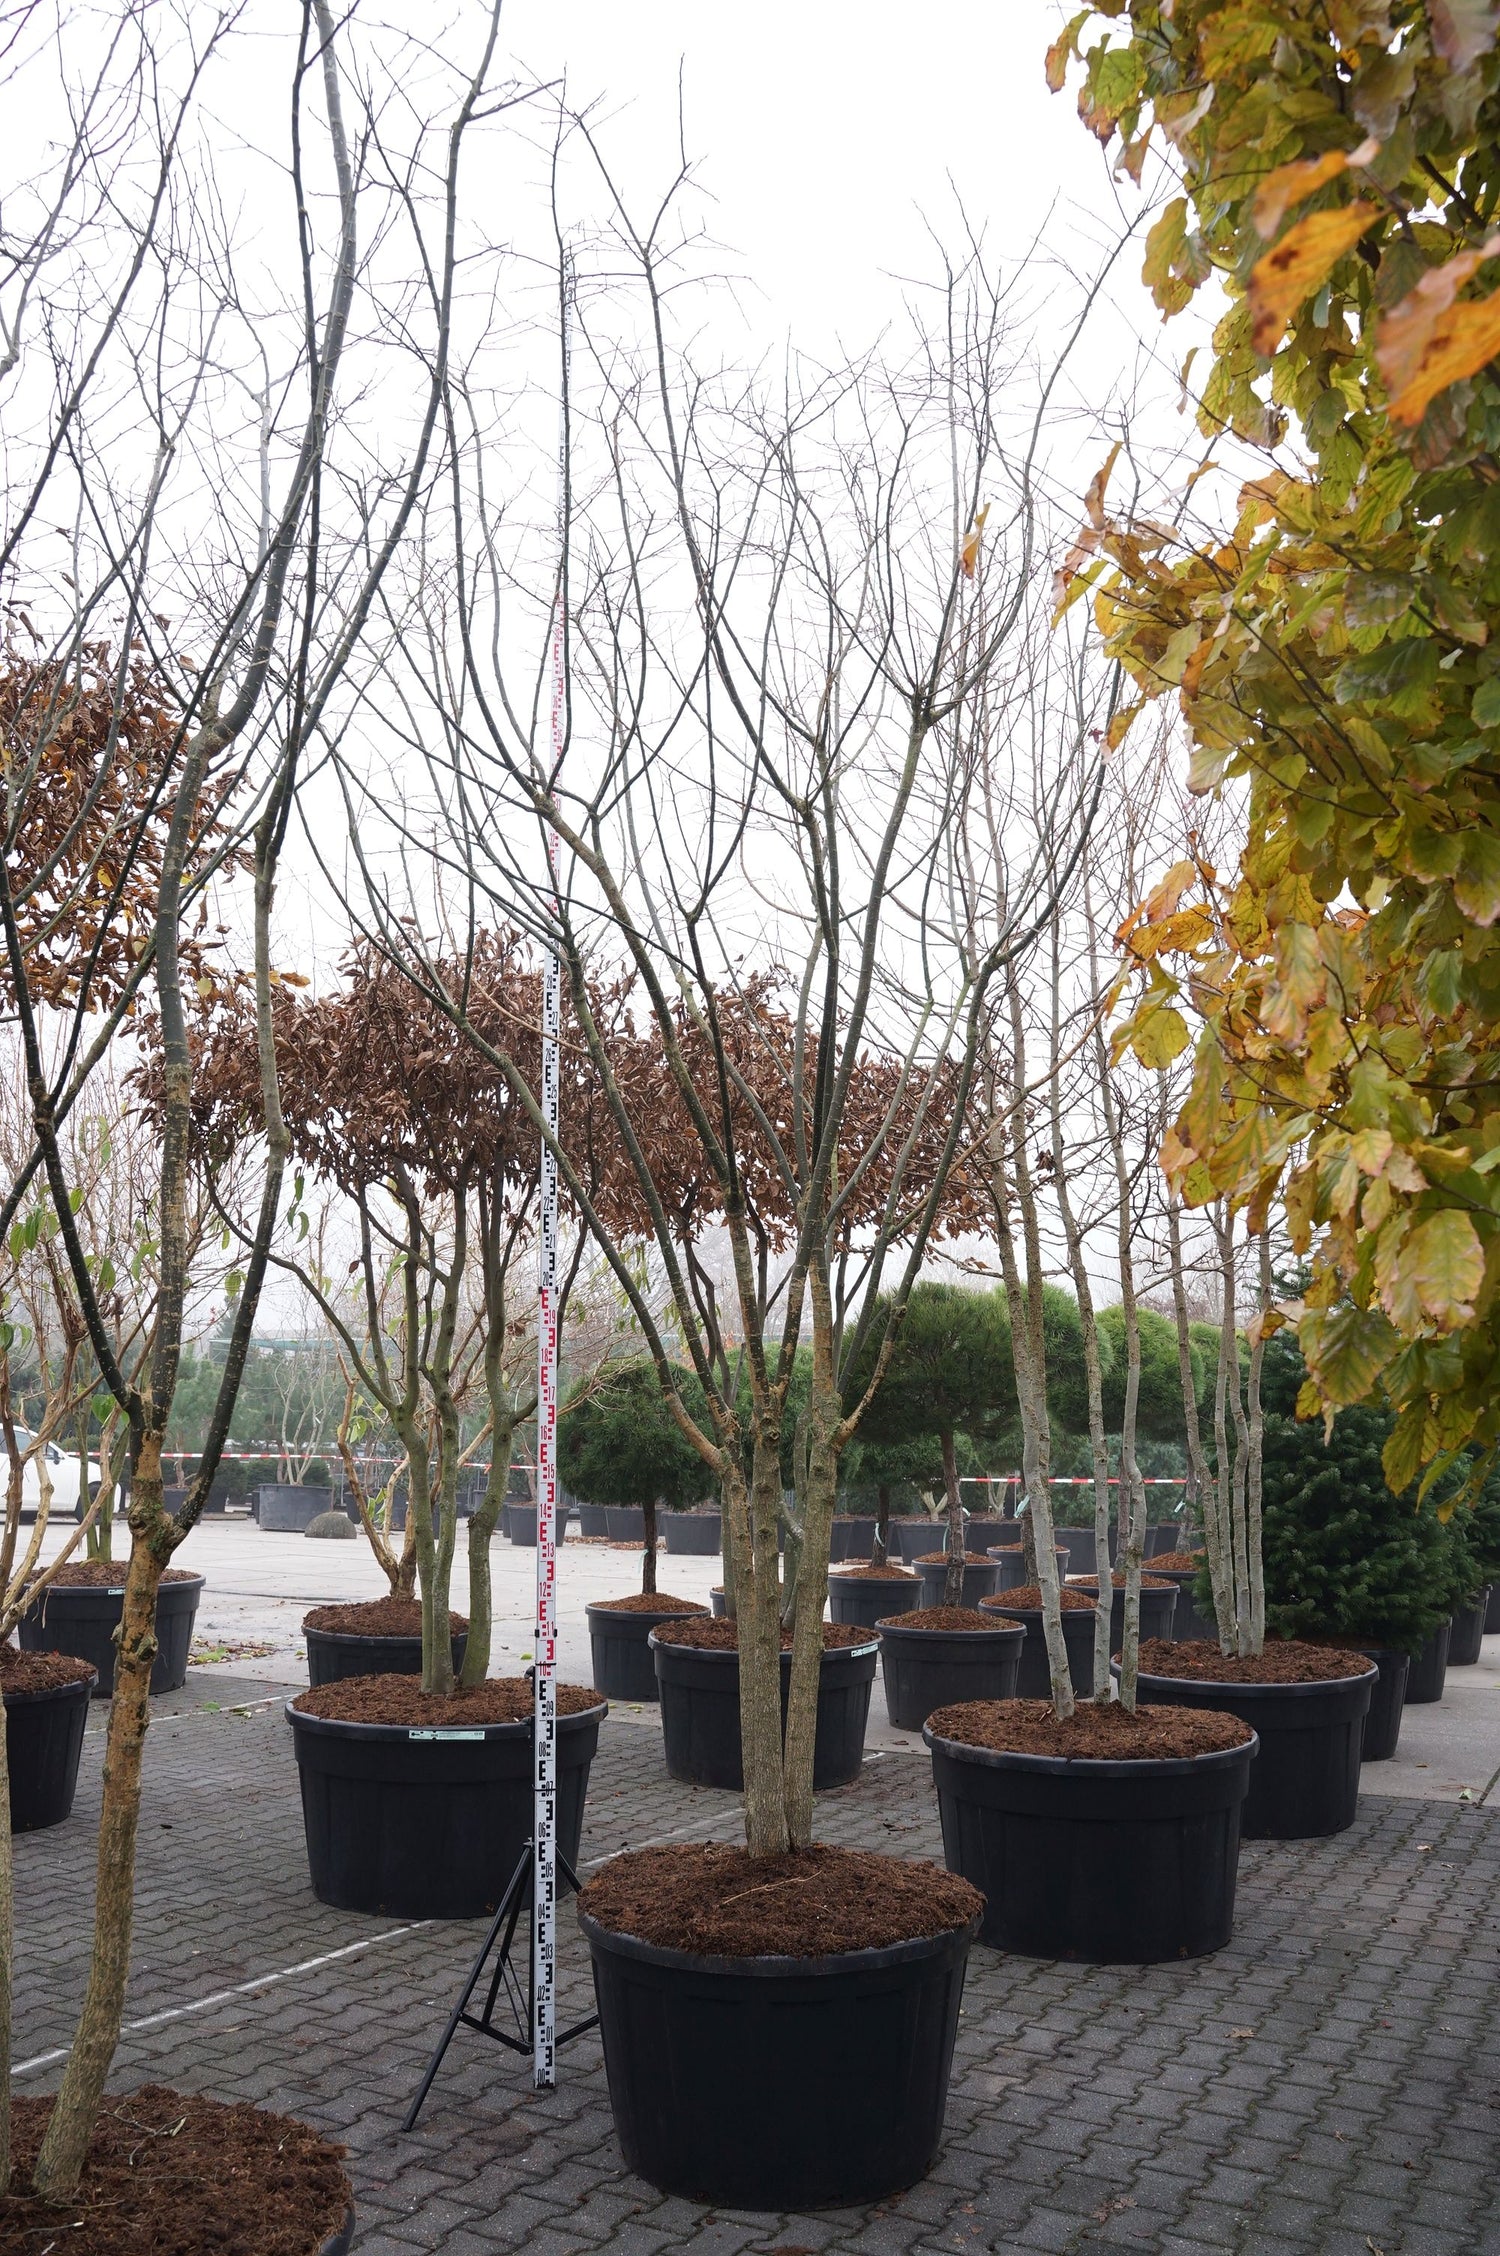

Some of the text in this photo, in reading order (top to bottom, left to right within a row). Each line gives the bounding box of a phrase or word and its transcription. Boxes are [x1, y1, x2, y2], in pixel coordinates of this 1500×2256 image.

[552, 1011, 558, 1025] 27
[550, 1085, 557, 1098] 25
[550, 1158, 556, 1173] 23
[544, 1196, 549, 1210] 22
[549, 1234, 556, 1248] 21
[542, 1272, 548, 1286] 20
[548, 1310, 556, 1324] 19
[540, 1348, 548, 1362] 18
[548, 1387, 555, 1401] 17
[540, 1425, 548, 1440] 16
[548, 1464, 555, 1479] 15
[540, 1504, 547, 1518] 14
[547, 1542, 554, 1557] 13
[540, 1582, 546, 1597] 12
[546, 1621, 554, 1636] 11
[540, 1661, 546, 1676] 10
[546, 1701, 553, 1716] 09
[539, 1741, 546, 1756] 08
[546, 1781, 553, 1796] 07
[538, 1822, 546, 1838] 06
[546, 1862, 553, 1877] 05
[538, 1904, 546, 1919] 04
[546, 1944, 553, 1960] 03
[538, 1986, 545, 2001] 02
[546, 2026, 553, 2042] 01
